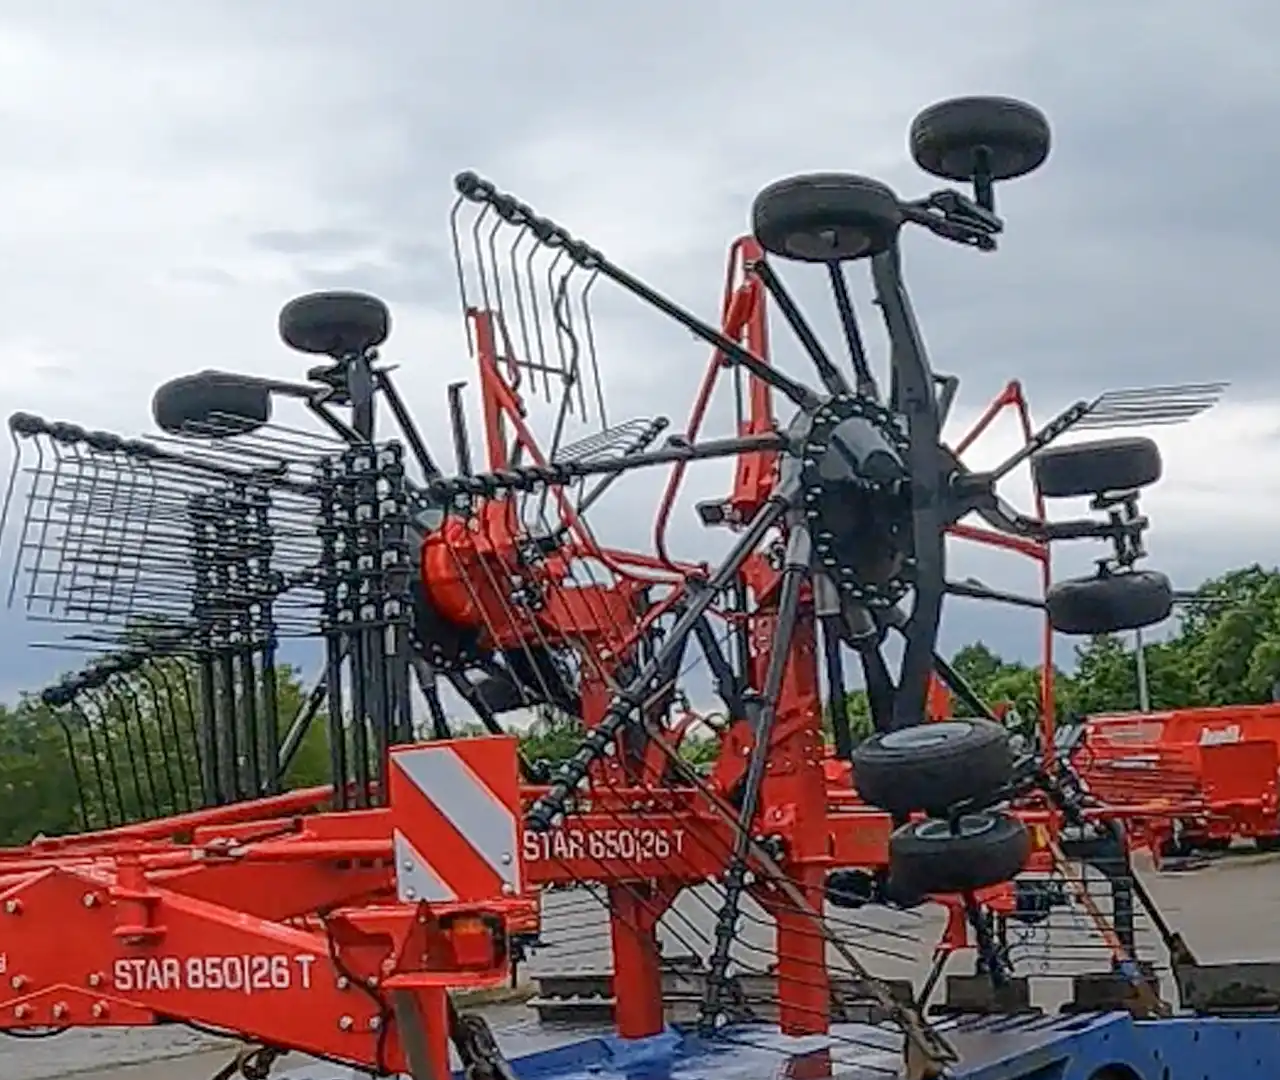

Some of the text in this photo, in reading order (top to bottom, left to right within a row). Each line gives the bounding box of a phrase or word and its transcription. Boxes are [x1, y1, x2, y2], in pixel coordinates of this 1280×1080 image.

[523, 830, 585, 861] STAR
[114, 957, 180, 990] STAR
[294, 953, 315, 988] T
